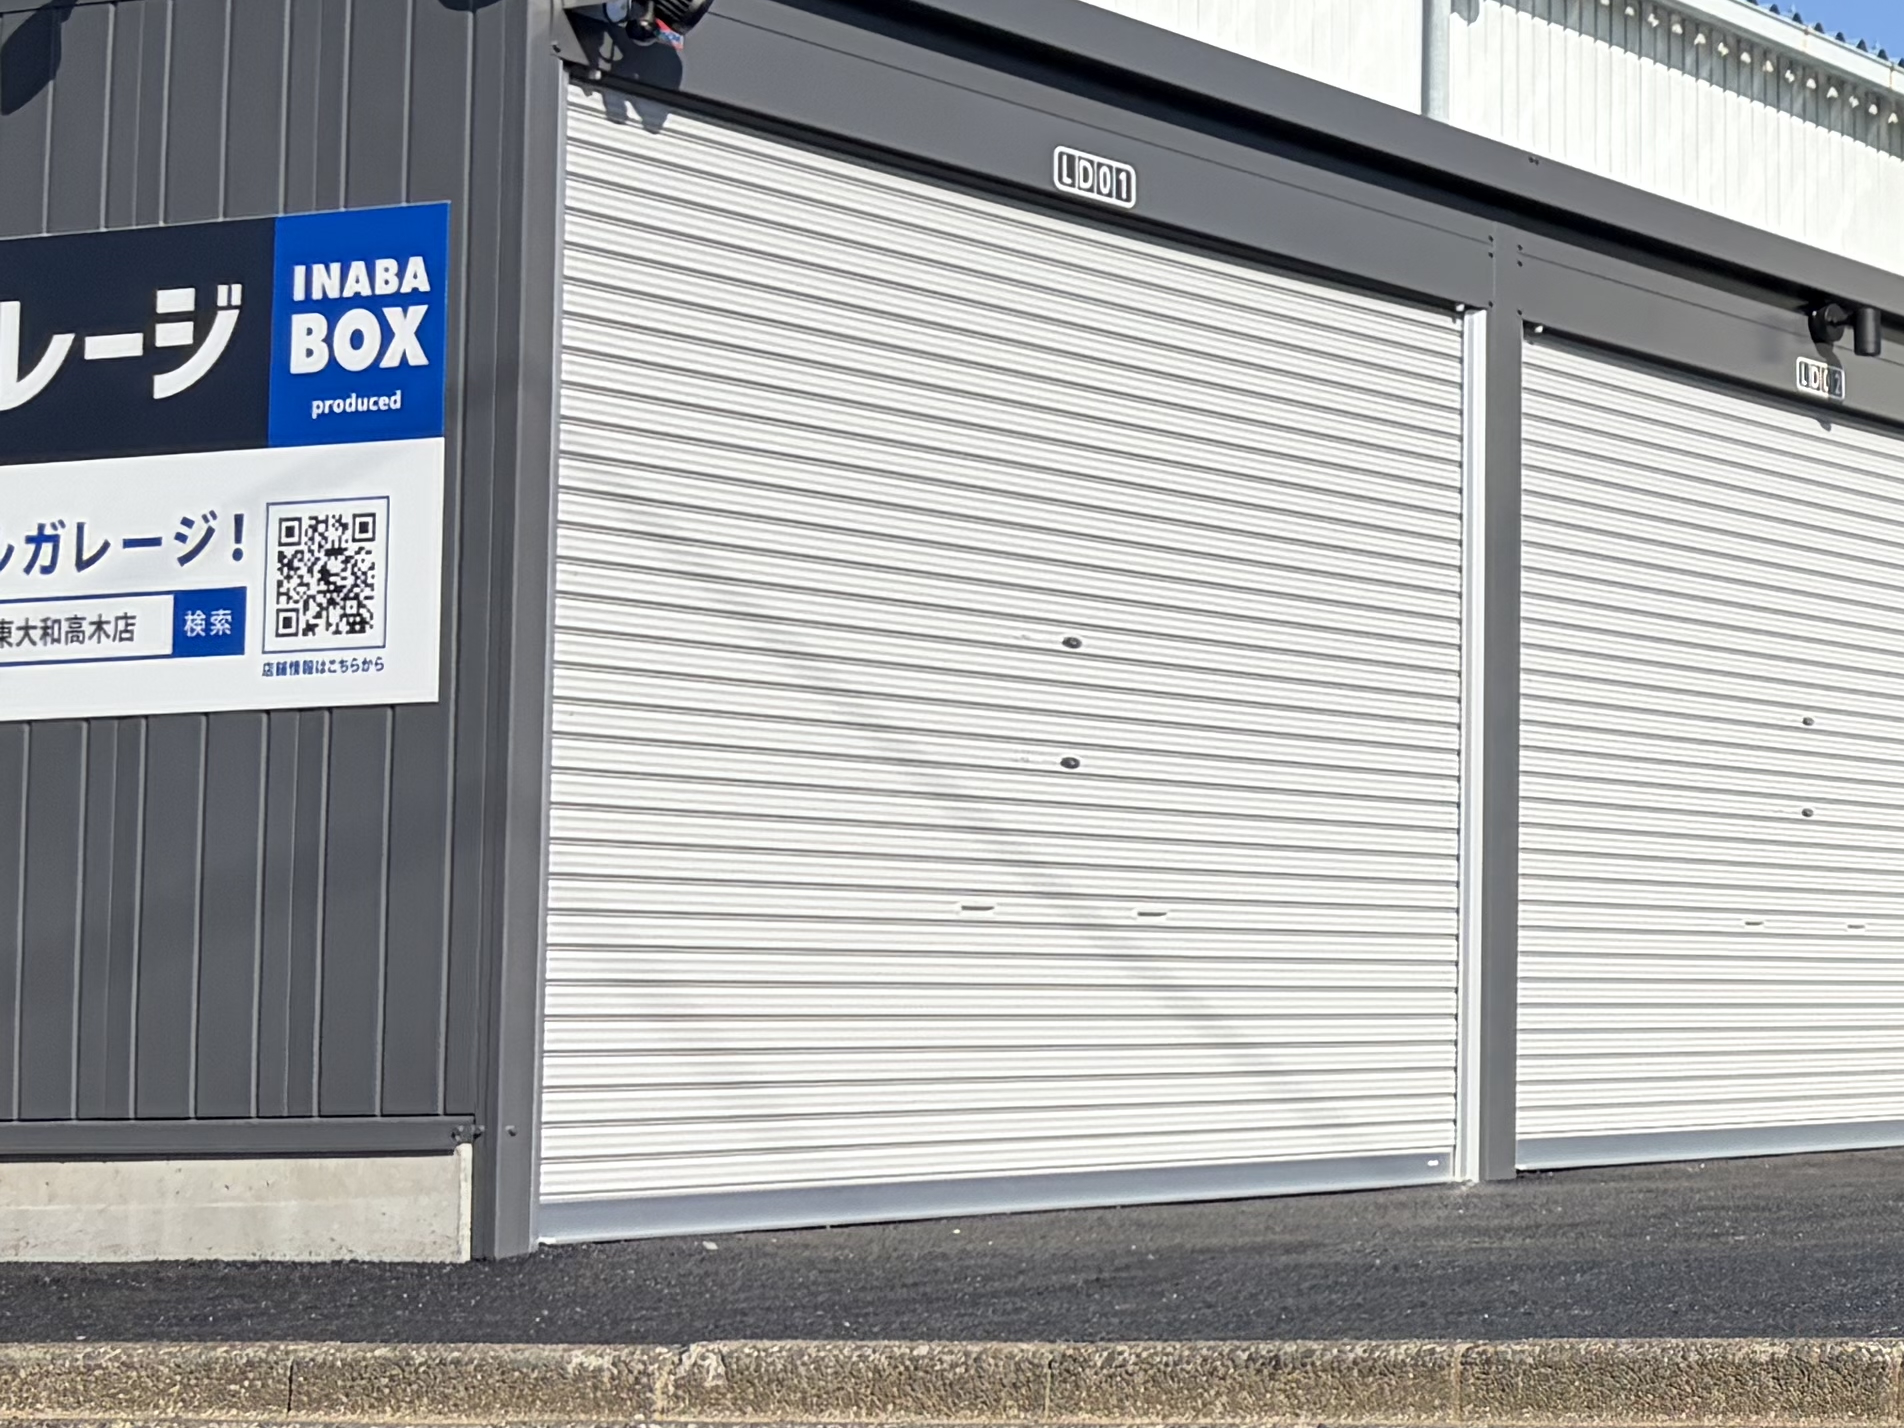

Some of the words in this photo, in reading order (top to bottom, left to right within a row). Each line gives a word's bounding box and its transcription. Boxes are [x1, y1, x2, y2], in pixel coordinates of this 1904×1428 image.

[1062, 154, 1127, 200] LD01
[293, 256, 430, 302] INABA
[0, 283, 242, 411] レージ
[289, 305, 429, 374] BOX
[311, 390, 402, 420] produced
[184, 609, 233, 638] 検索
